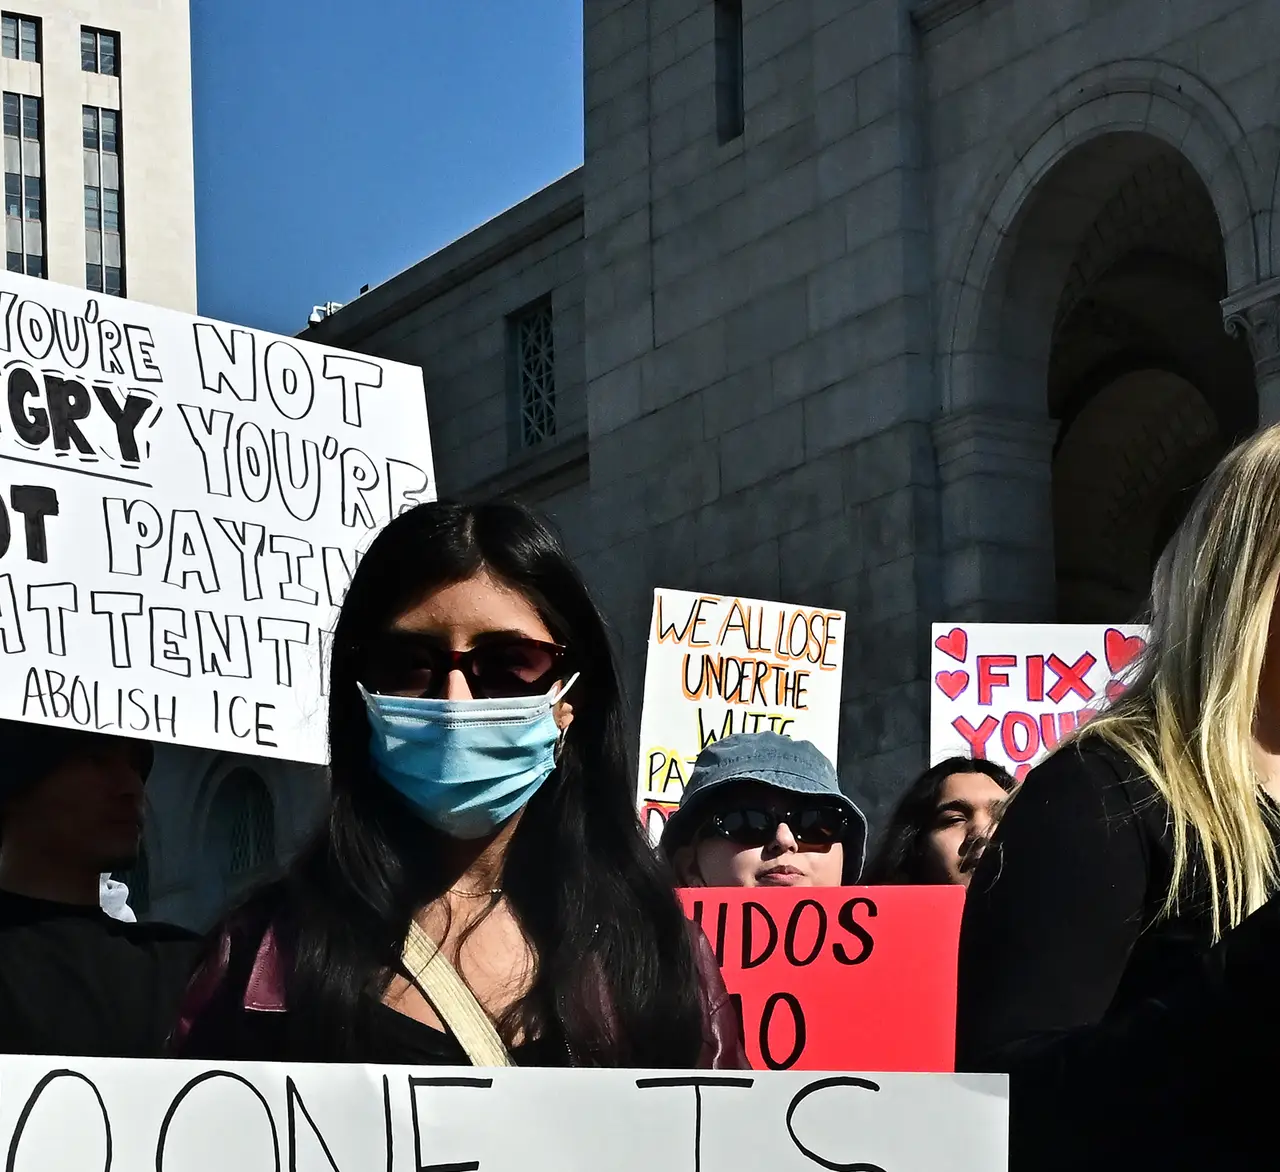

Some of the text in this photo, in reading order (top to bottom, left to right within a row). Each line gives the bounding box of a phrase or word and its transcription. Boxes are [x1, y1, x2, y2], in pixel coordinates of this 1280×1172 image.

[194, 322, 383, 428] NOT
[102, 496, 364, 607] PAYIN
[656, 595, 841, 671] WE ALL LOSE
[22, 665, 278, 748] ABOLISH ICE
[682, 654, 811, 710] UNDER THE
[976, 651, 1097, 706] FIX
